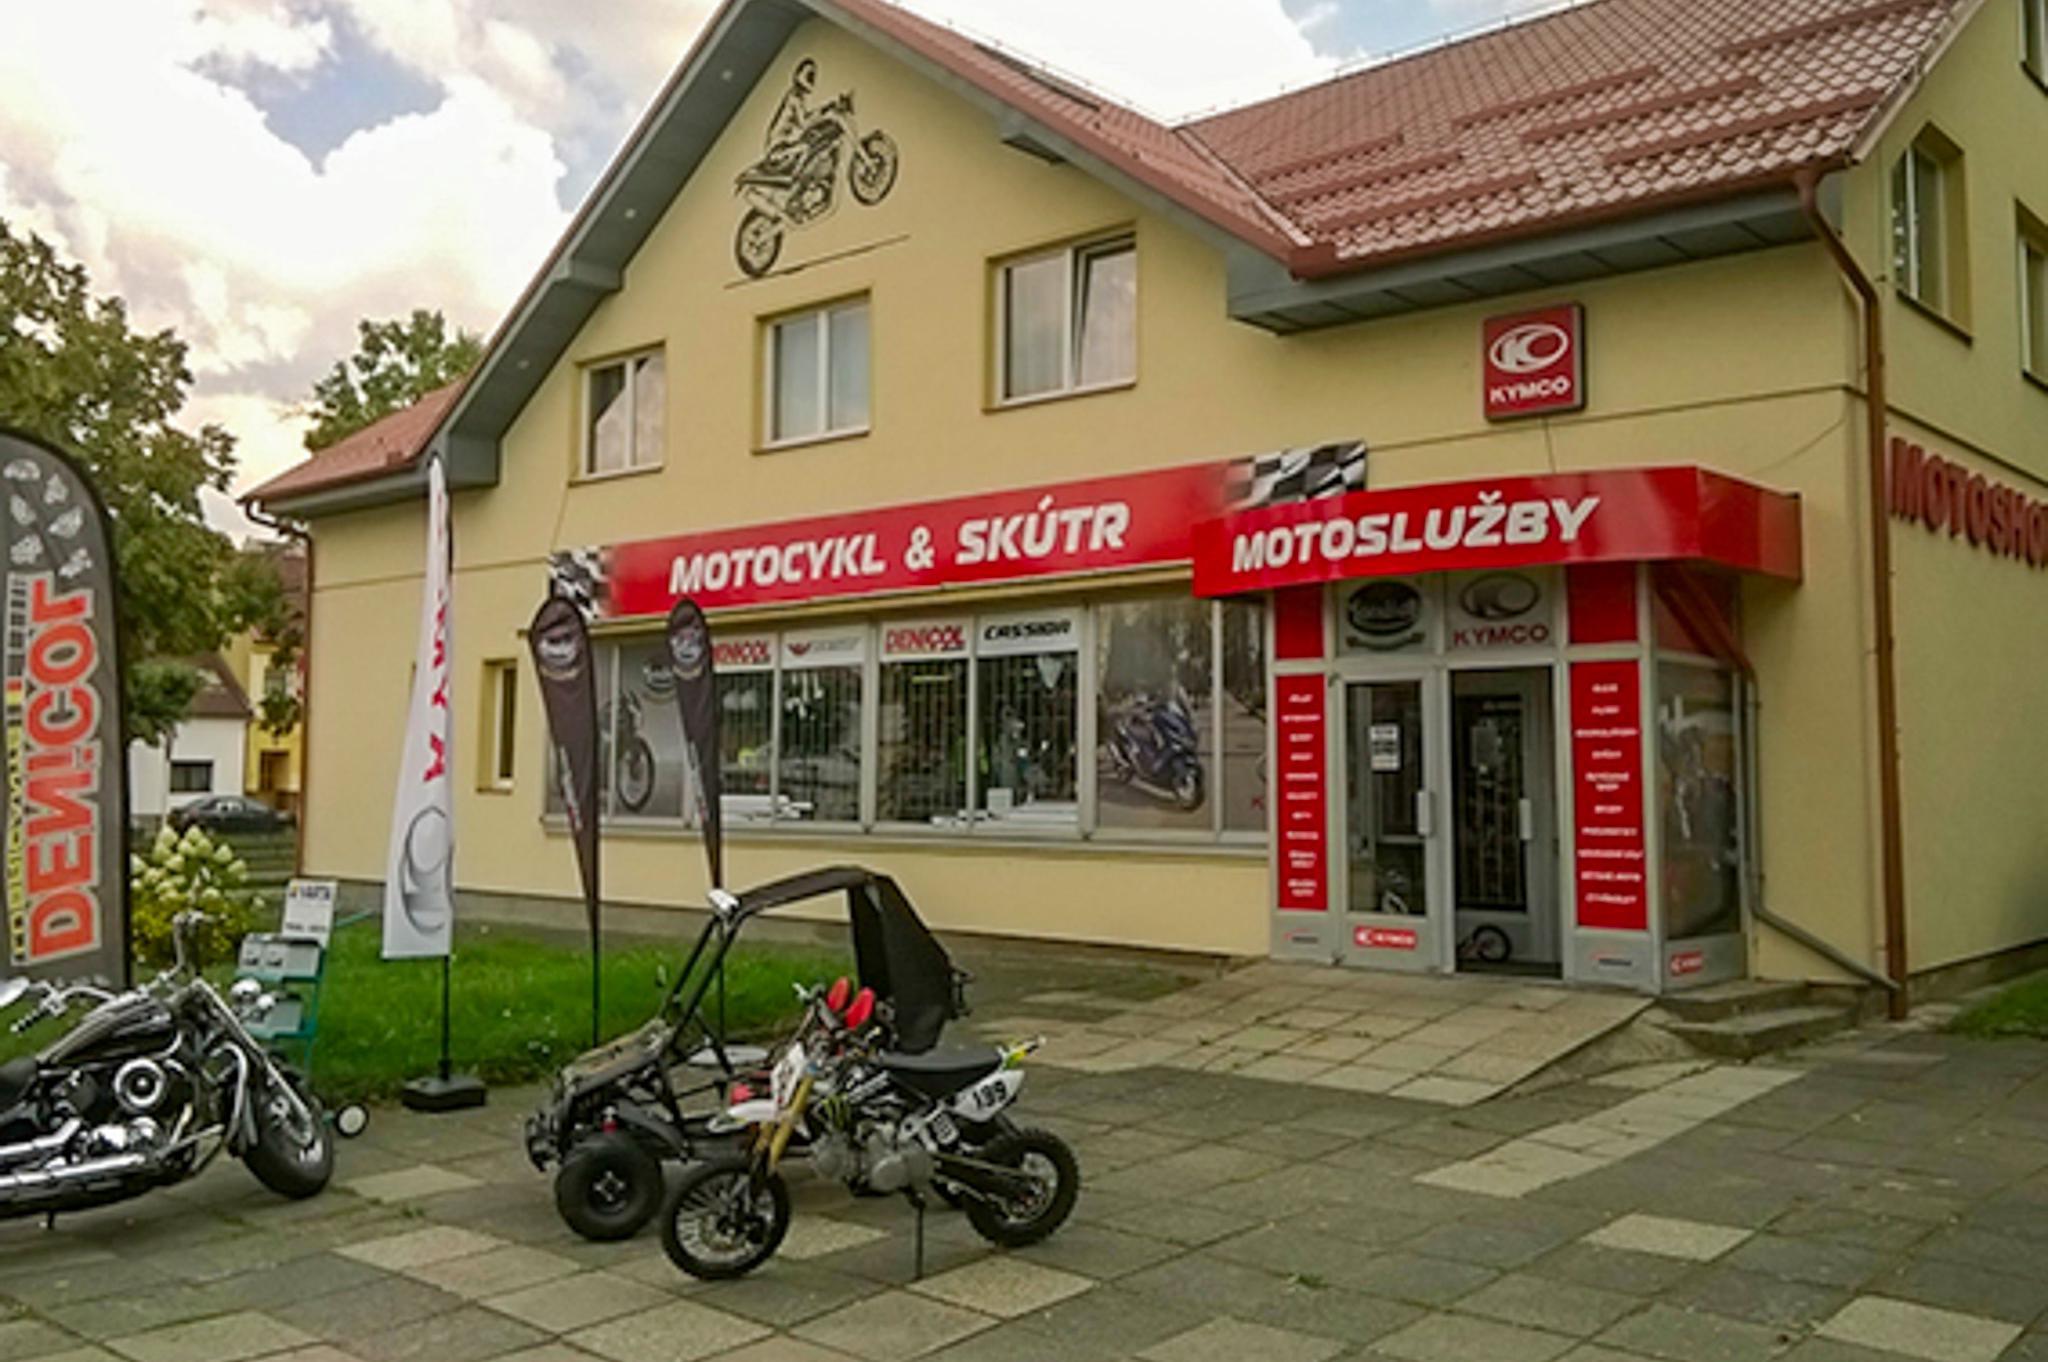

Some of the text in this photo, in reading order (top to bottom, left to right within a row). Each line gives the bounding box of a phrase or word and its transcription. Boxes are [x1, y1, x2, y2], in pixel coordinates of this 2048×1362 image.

[1490, 375, 1571, 403] KYMCO
[668, 496, 1130, 597] MOTOCYKL & SKÚTR
[1232, 490, 1600, 572] MOTOSLUŽBY
[1453, 623, 1549, 647] KYMCO
